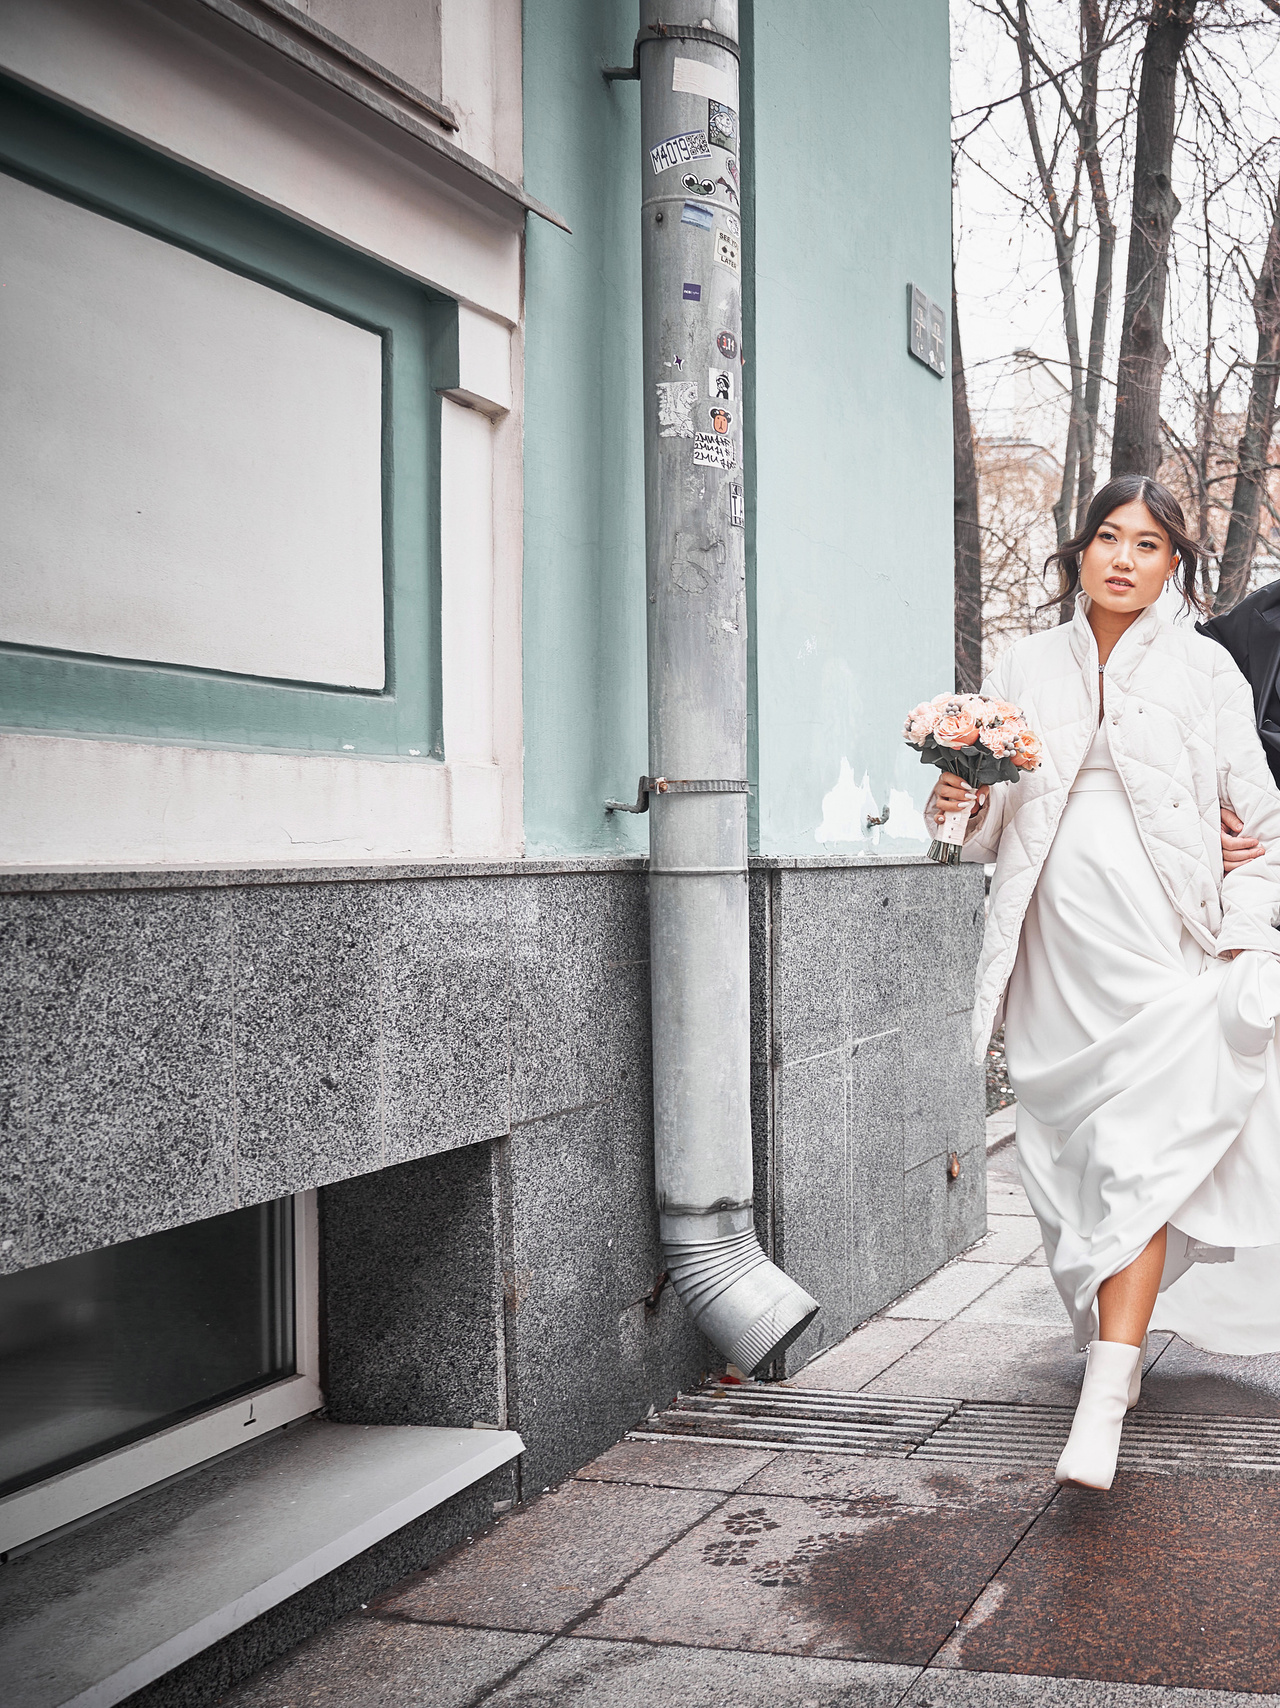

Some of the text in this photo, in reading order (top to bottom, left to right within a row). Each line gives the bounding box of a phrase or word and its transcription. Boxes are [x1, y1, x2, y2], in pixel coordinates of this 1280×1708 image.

[652, 138, 691, 172] M4019
[719, 232, 731, 243] SEE
[720, 256, 737, 269] LATER
